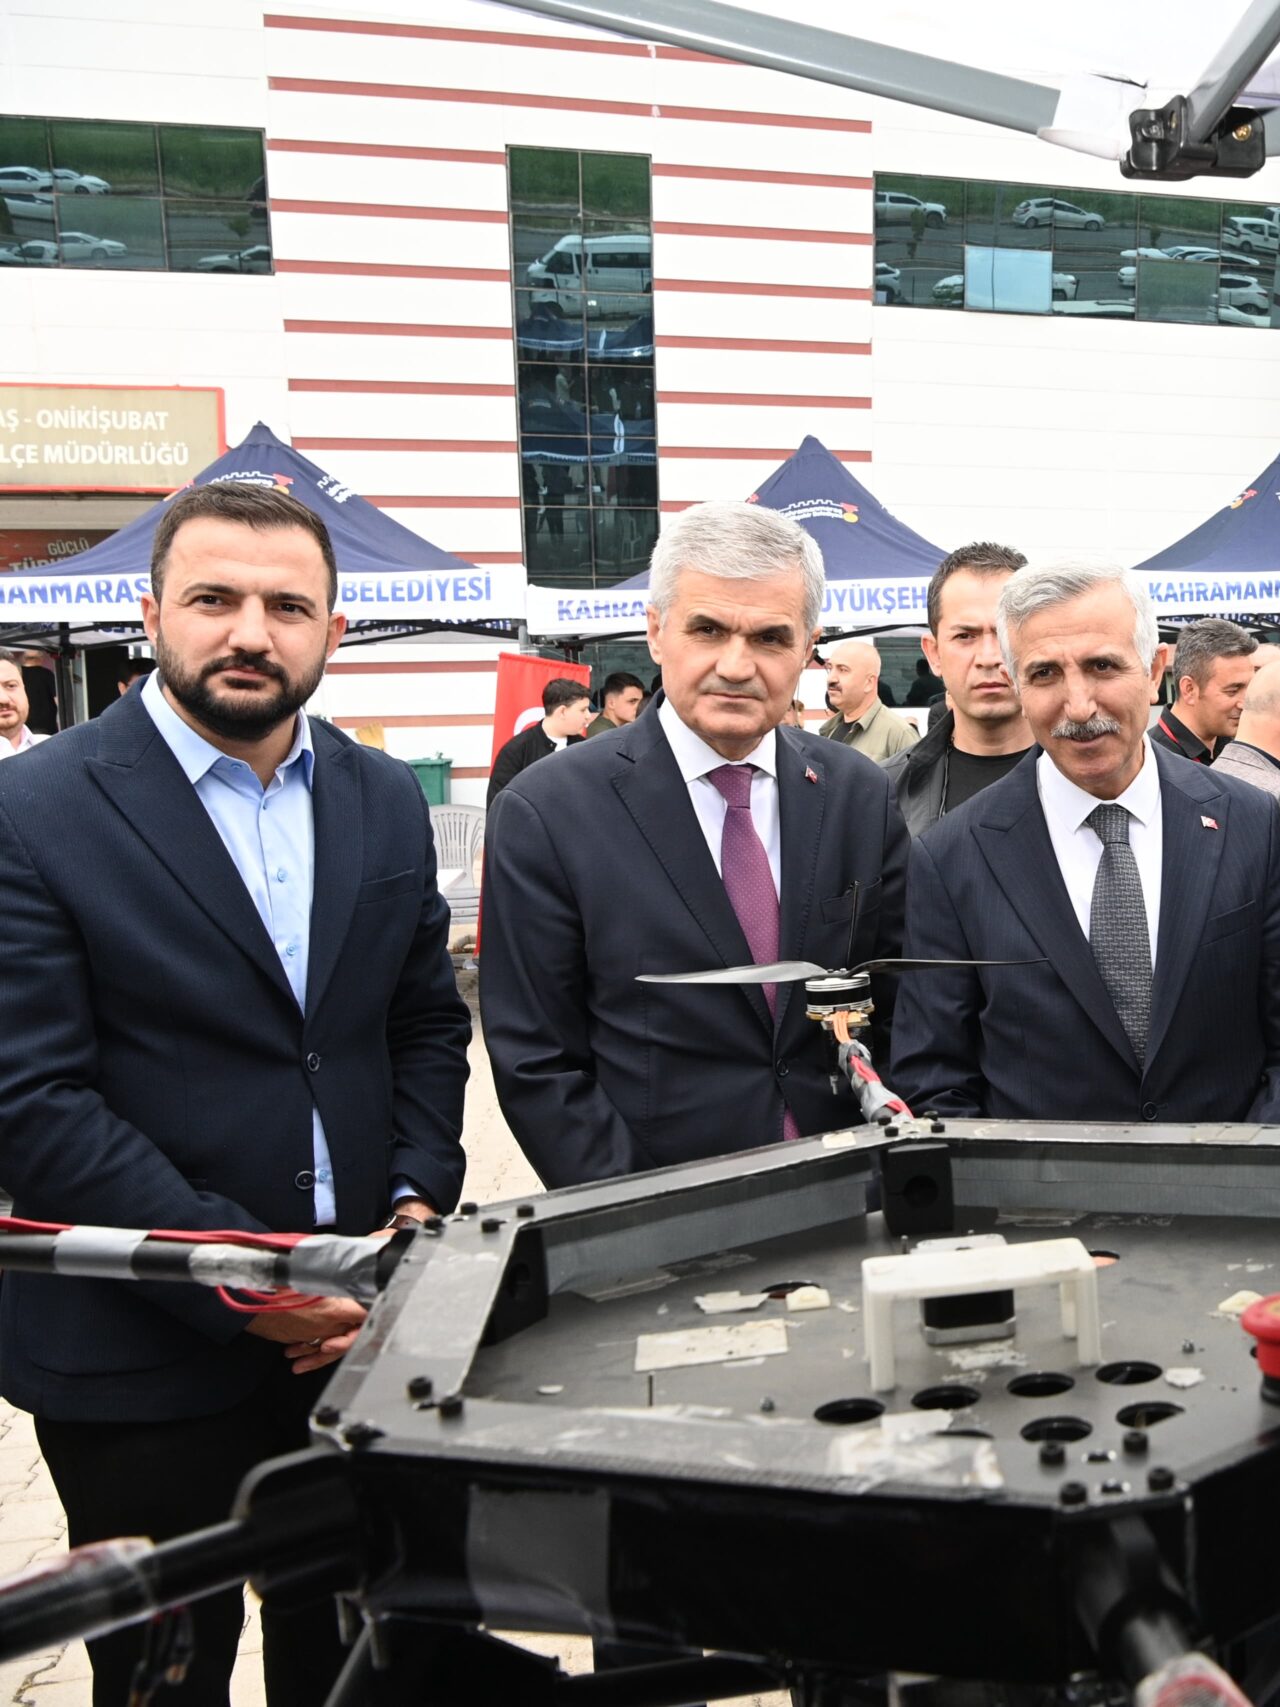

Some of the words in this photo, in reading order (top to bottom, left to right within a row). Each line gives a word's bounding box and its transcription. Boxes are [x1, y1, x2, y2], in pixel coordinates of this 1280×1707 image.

[36, 405, 168, 433] ONİKİŞUBAT
[44, 440, 189, 466] MÜDÜRLÜĞÜ
[341, 570, 492, 603] BELEDİYESİ
